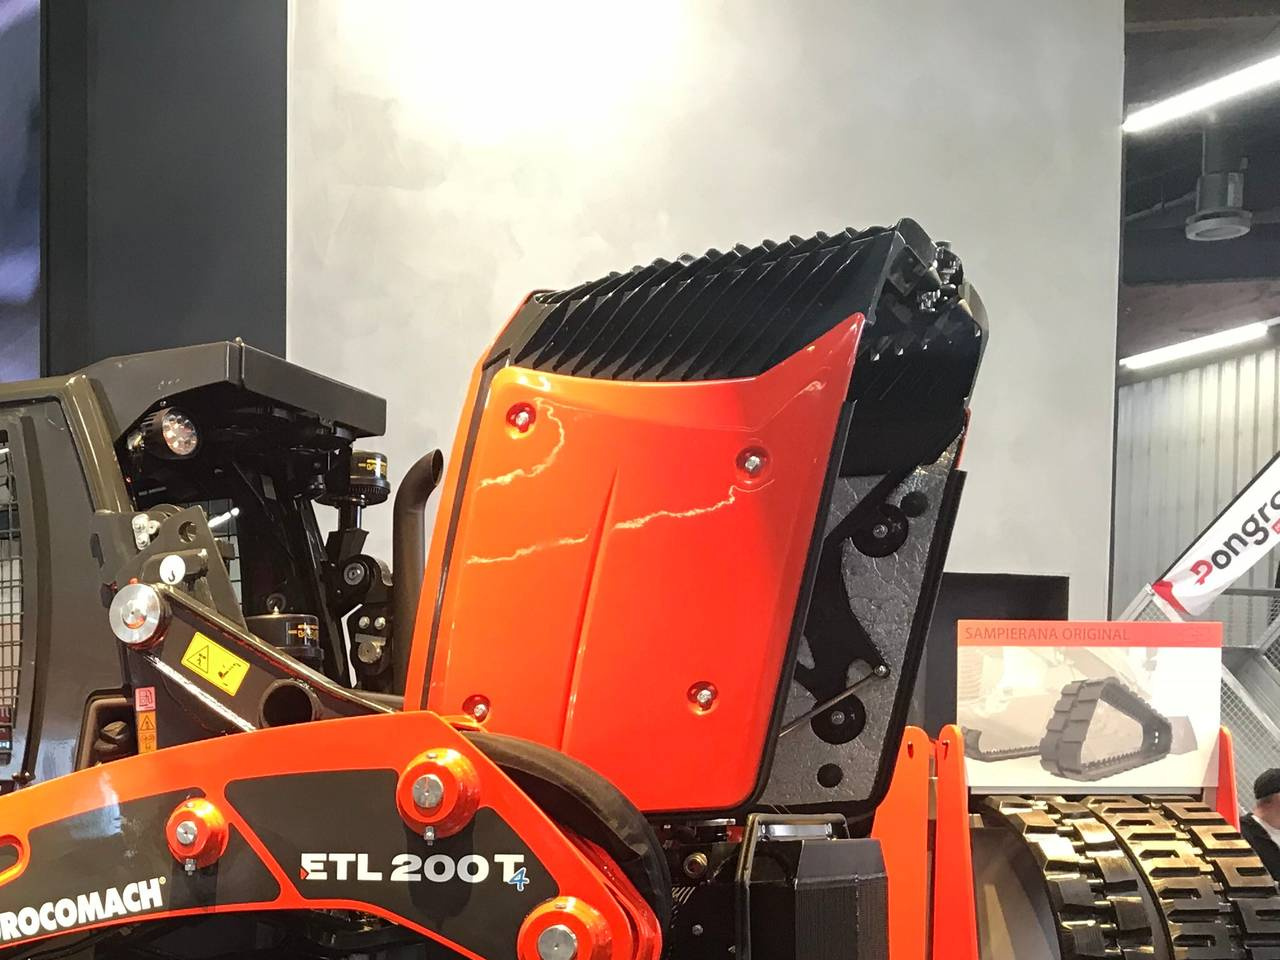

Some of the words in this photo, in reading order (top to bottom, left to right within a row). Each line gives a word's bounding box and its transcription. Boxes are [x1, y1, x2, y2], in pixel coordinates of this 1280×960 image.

[964, 627, 1059, 641] SAMPIERANA
[1062, 627, 1130, 642] ORIGINAL
[301, 853, 383, 881] ETL
